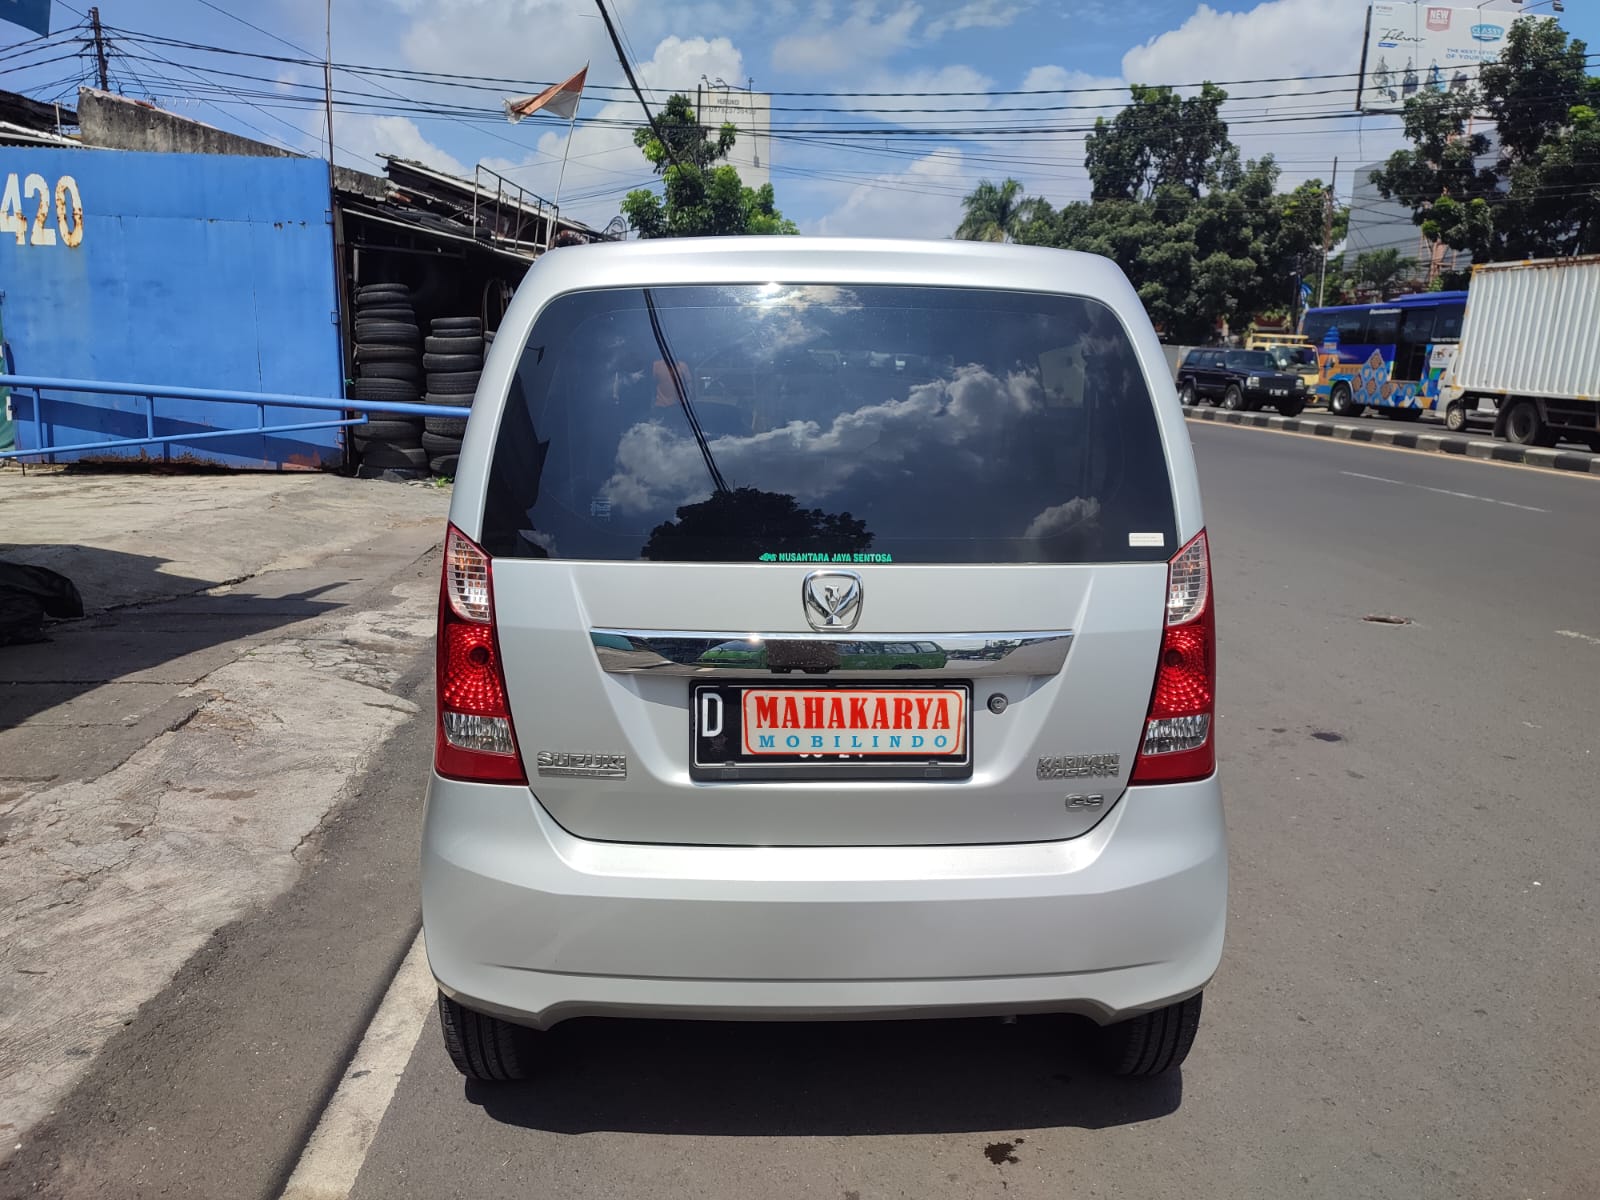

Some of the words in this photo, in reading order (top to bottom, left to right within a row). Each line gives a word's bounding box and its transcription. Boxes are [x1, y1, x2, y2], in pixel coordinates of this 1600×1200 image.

[1430, 9, 1449, 19] NEW
[1471, 26, 1502, 36] CLASSY
[0, 172, 84, 248] 420
[778, 552, 829, 562] NUSANTARA
[831, 552, 852, 562] JAYA
[853, 553, 893, 563] SENTOSA
[702, 692, 723, 737] D
[754, 695, 951, 730] MAHAKARYA
[758, 734, 949, 749] MOBILINDO
[538, 751, 626, 769] SUZUKI
